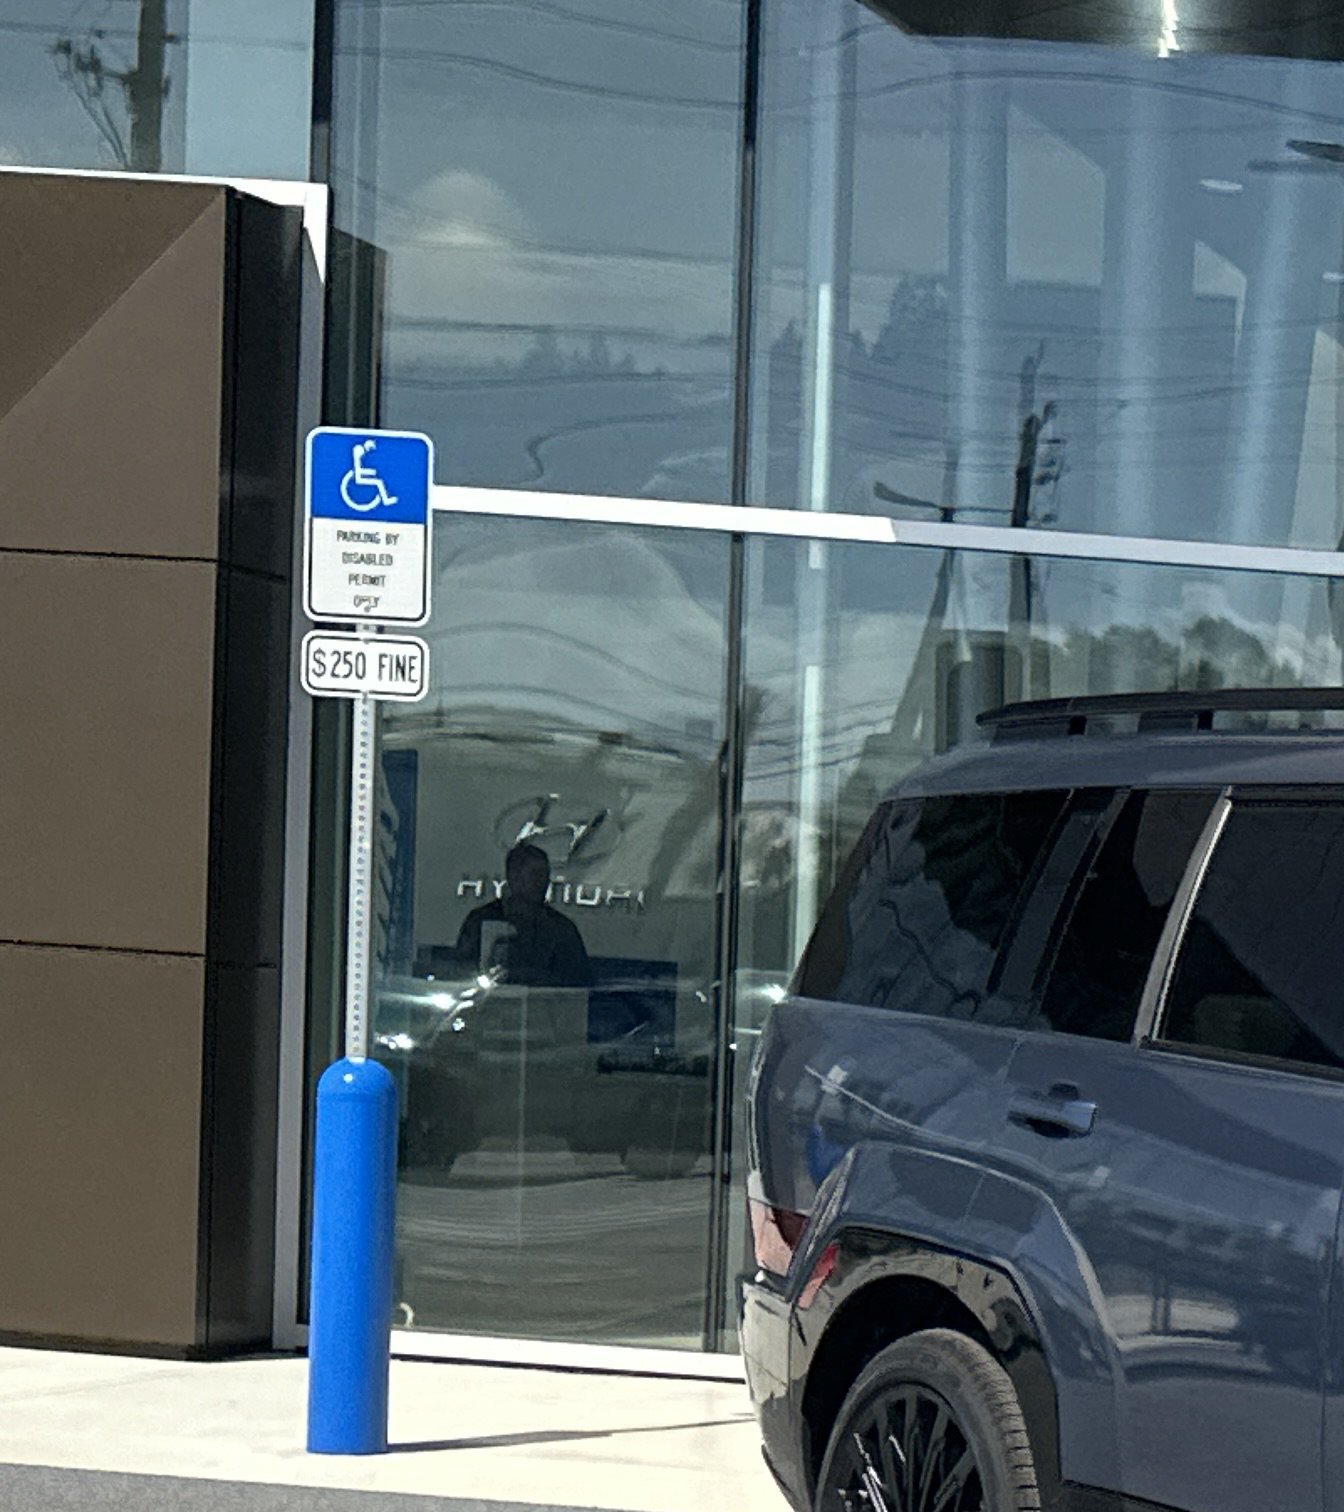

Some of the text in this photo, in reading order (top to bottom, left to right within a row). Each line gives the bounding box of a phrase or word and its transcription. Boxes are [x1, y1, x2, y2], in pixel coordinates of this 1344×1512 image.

[337, 529, 400, 546] PARKING BY
[342, 551, 393, 567] DISABLED
[348, 573, 386, 588] PERMIT
[312, 648, 419, 684] $250 FINE
